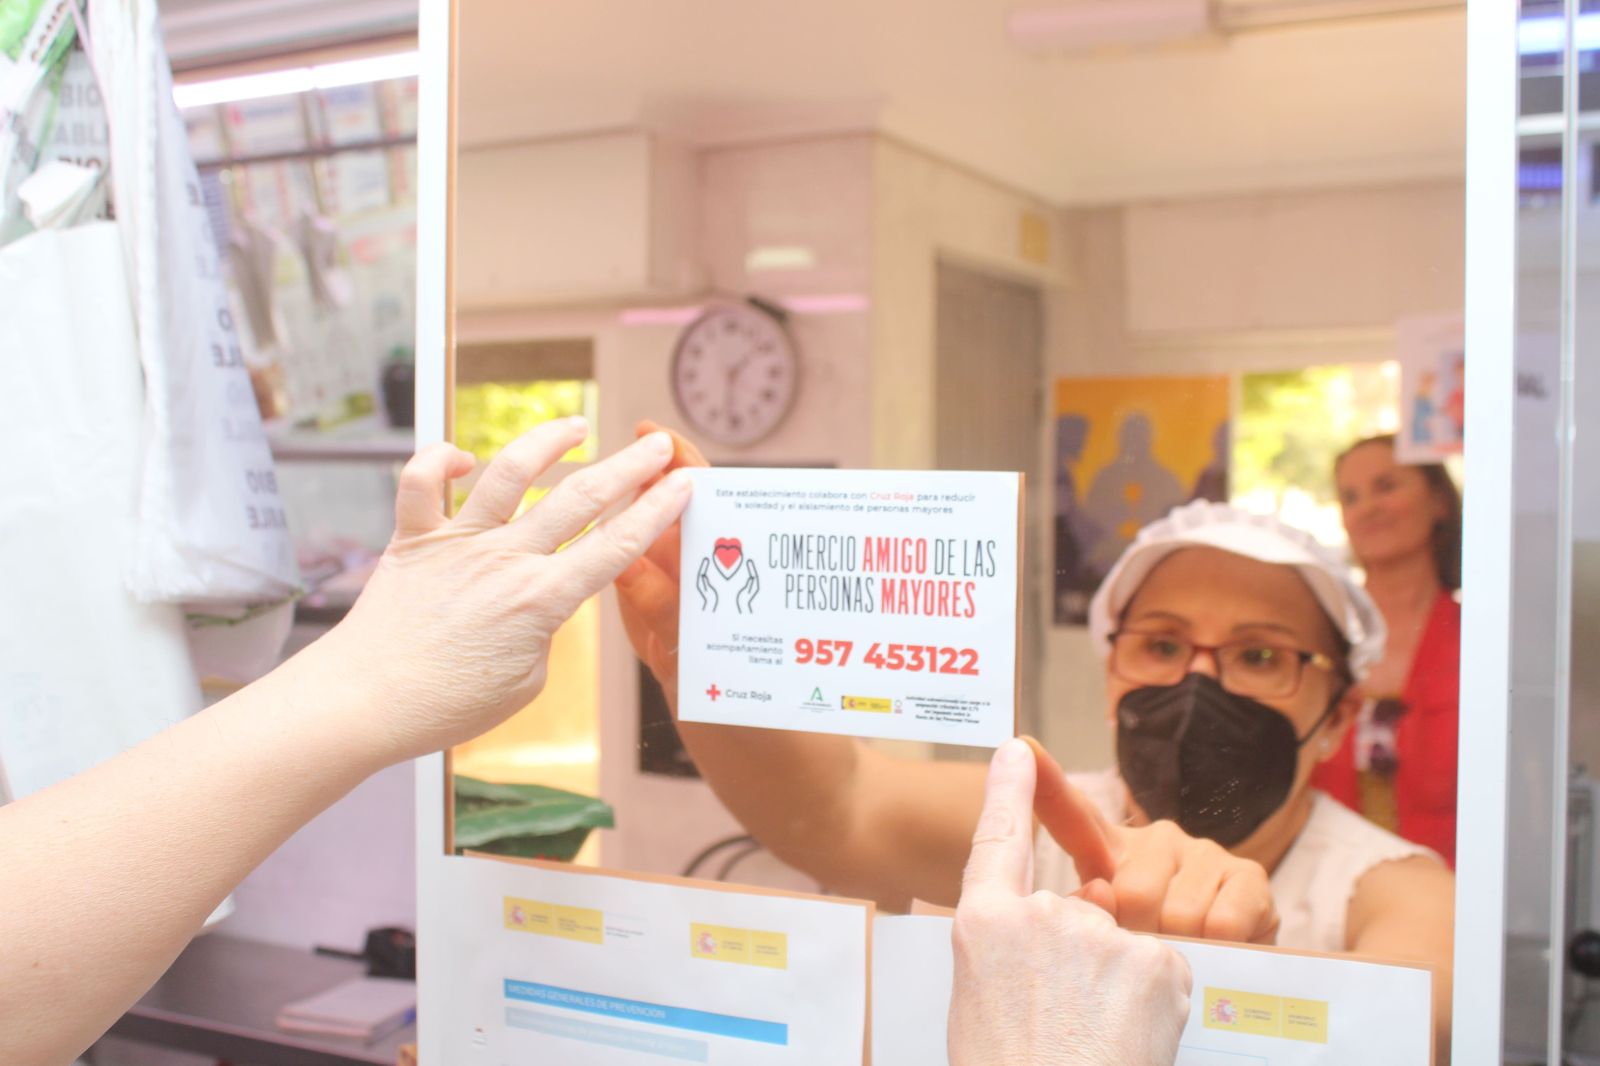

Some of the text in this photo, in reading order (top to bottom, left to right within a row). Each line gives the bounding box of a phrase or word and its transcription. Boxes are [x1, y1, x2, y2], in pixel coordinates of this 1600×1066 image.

[715, 488, 976, 503] Este establecimiento colabora con Cruz Roja para reducir
[745, 501, 779, 510] soledad
[798, 502, 851, 512] aislamiento
[853, 503, 865, 512] de
[867, 504, 910, 514] personas
[912, 506, 954, 515] mayores
[768, 533, 997, 578] COMERCIO AMIGO DE LAS
[785, 574, 977, 619] PERSONAS MAYORES
[742, 635, 784, 644] necesitas
[748, 655, 773, 665] llama
[794, 638, 980, 676] 957 453122
[725, 689, 772, 702] Cruz Roja
